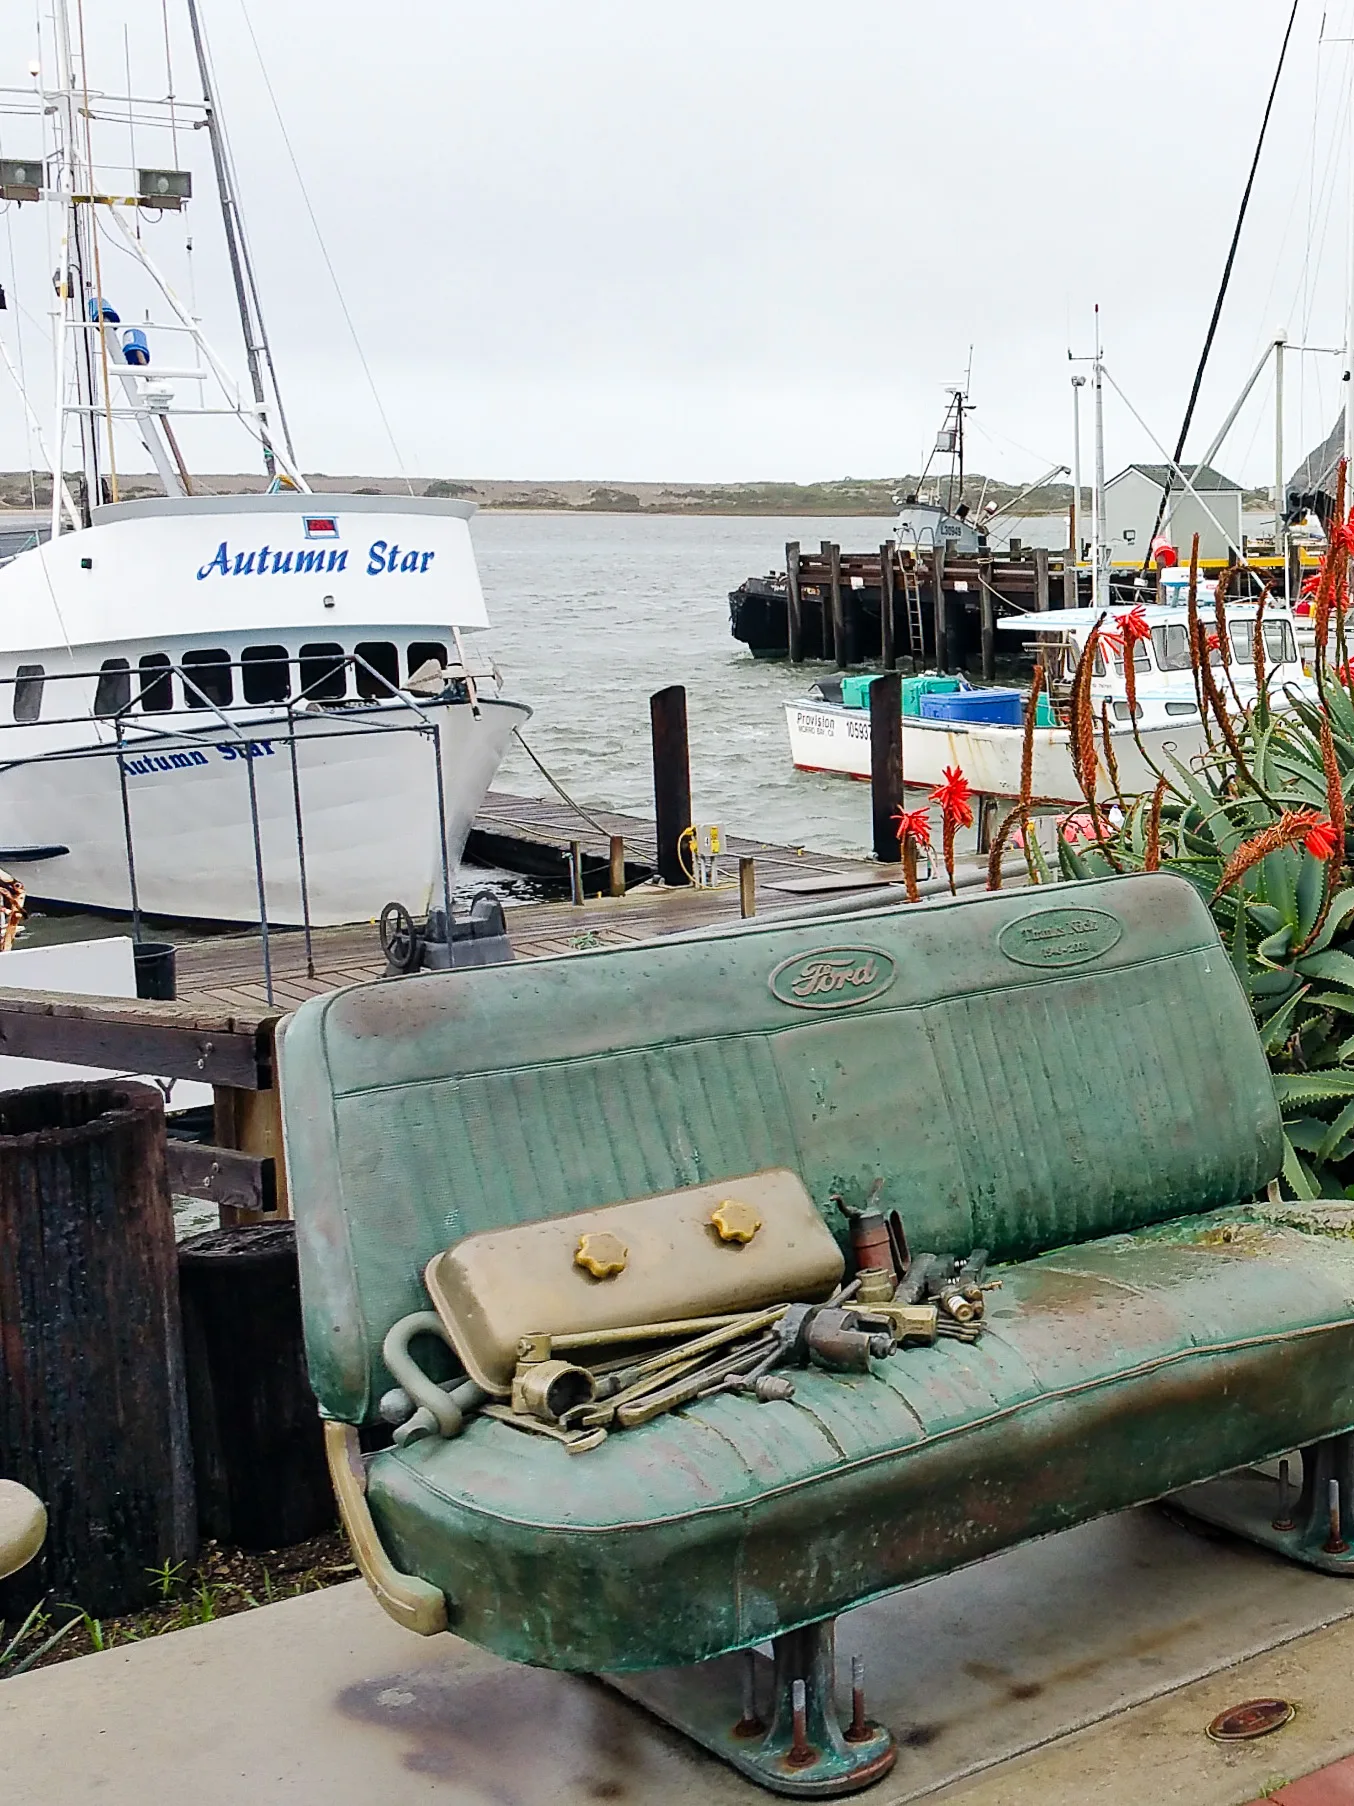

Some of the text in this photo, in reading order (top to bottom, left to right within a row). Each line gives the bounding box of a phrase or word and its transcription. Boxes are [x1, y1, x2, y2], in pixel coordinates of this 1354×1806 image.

[197, 540, 435, 581] Autumn Star
[797, 712, 835, 729] Provision
[791, 957, 880, 997] Ford
